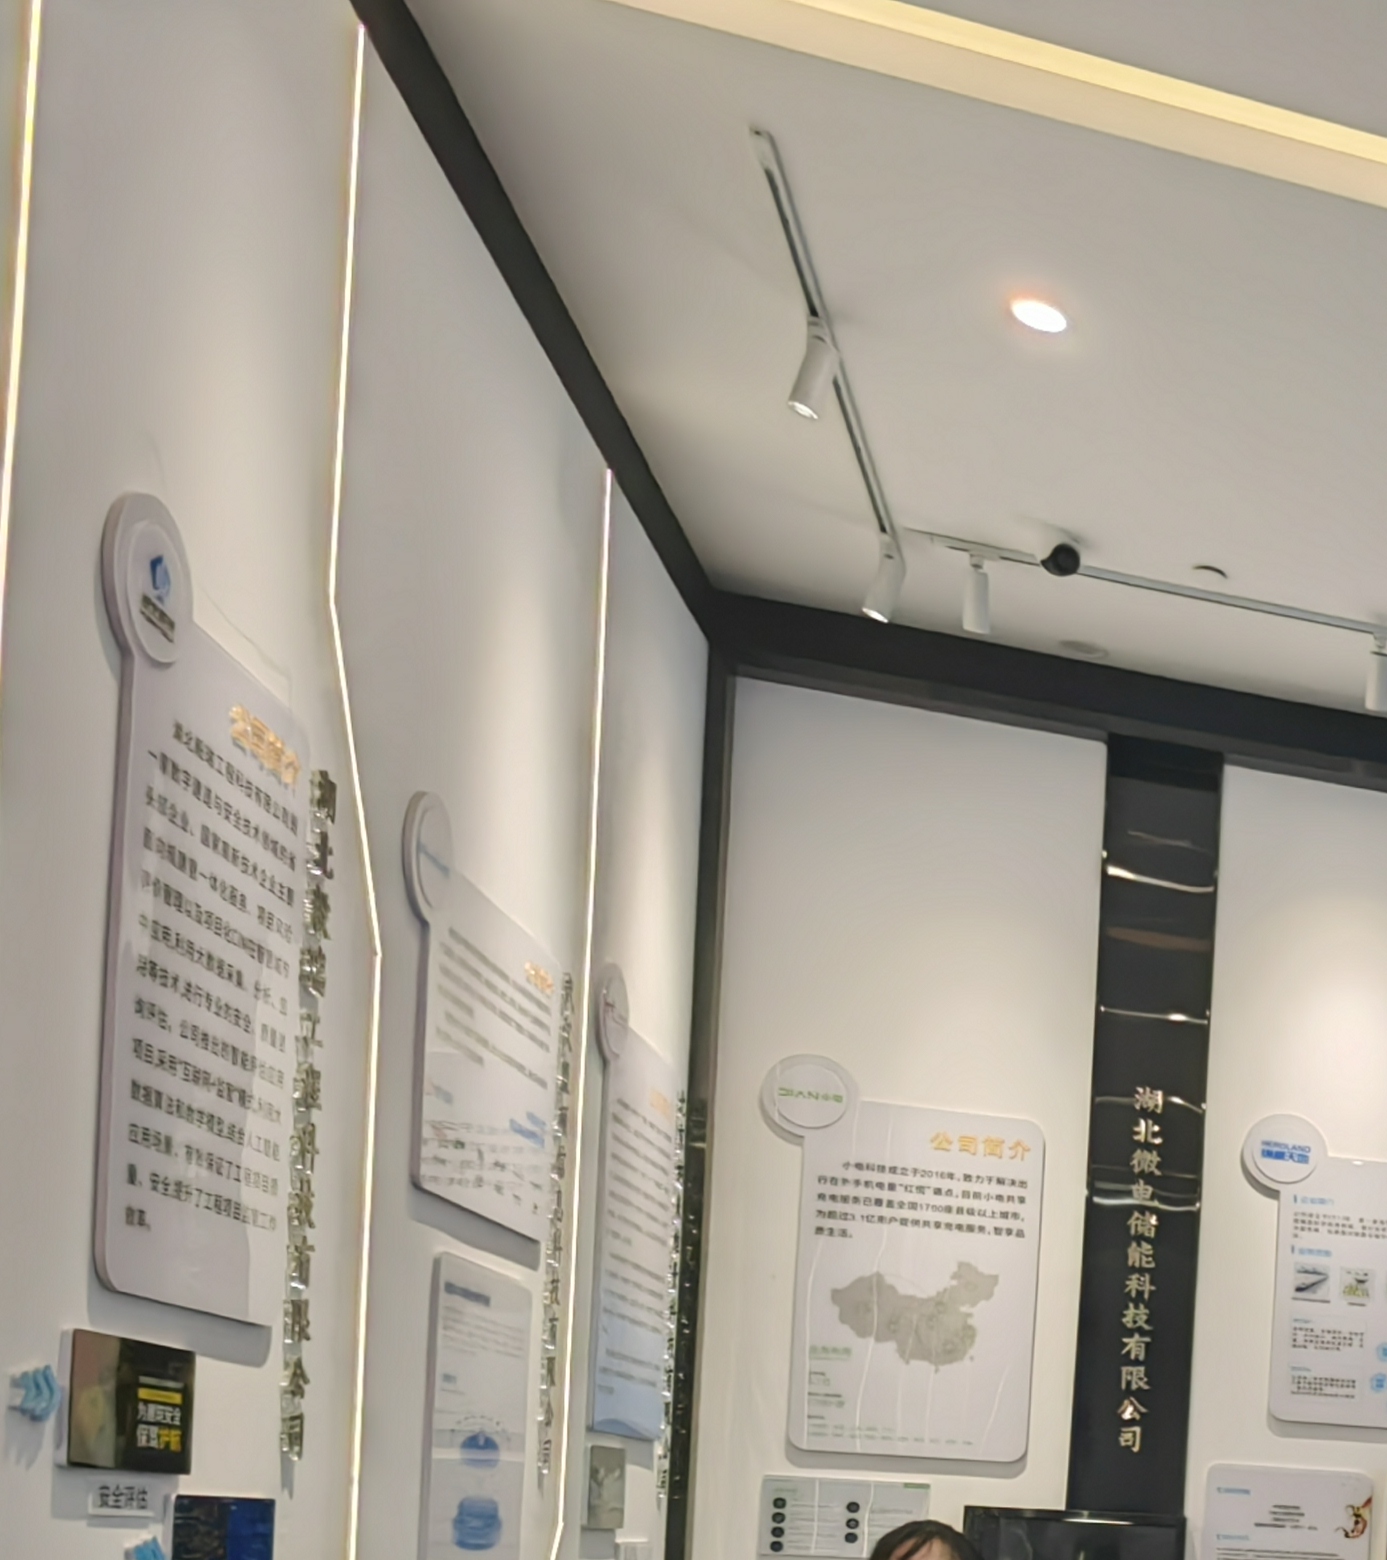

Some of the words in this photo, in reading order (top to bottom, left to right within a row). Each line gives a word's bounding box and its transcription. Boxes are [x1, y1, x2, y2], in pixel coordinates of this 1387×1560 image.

[930, 1131, 1031, 1161] 公司简介
[1118, 1085, 1164, 1453] 湖北微电储能科技有限公司
[98, 1485, 148, 1510] 安全评估
